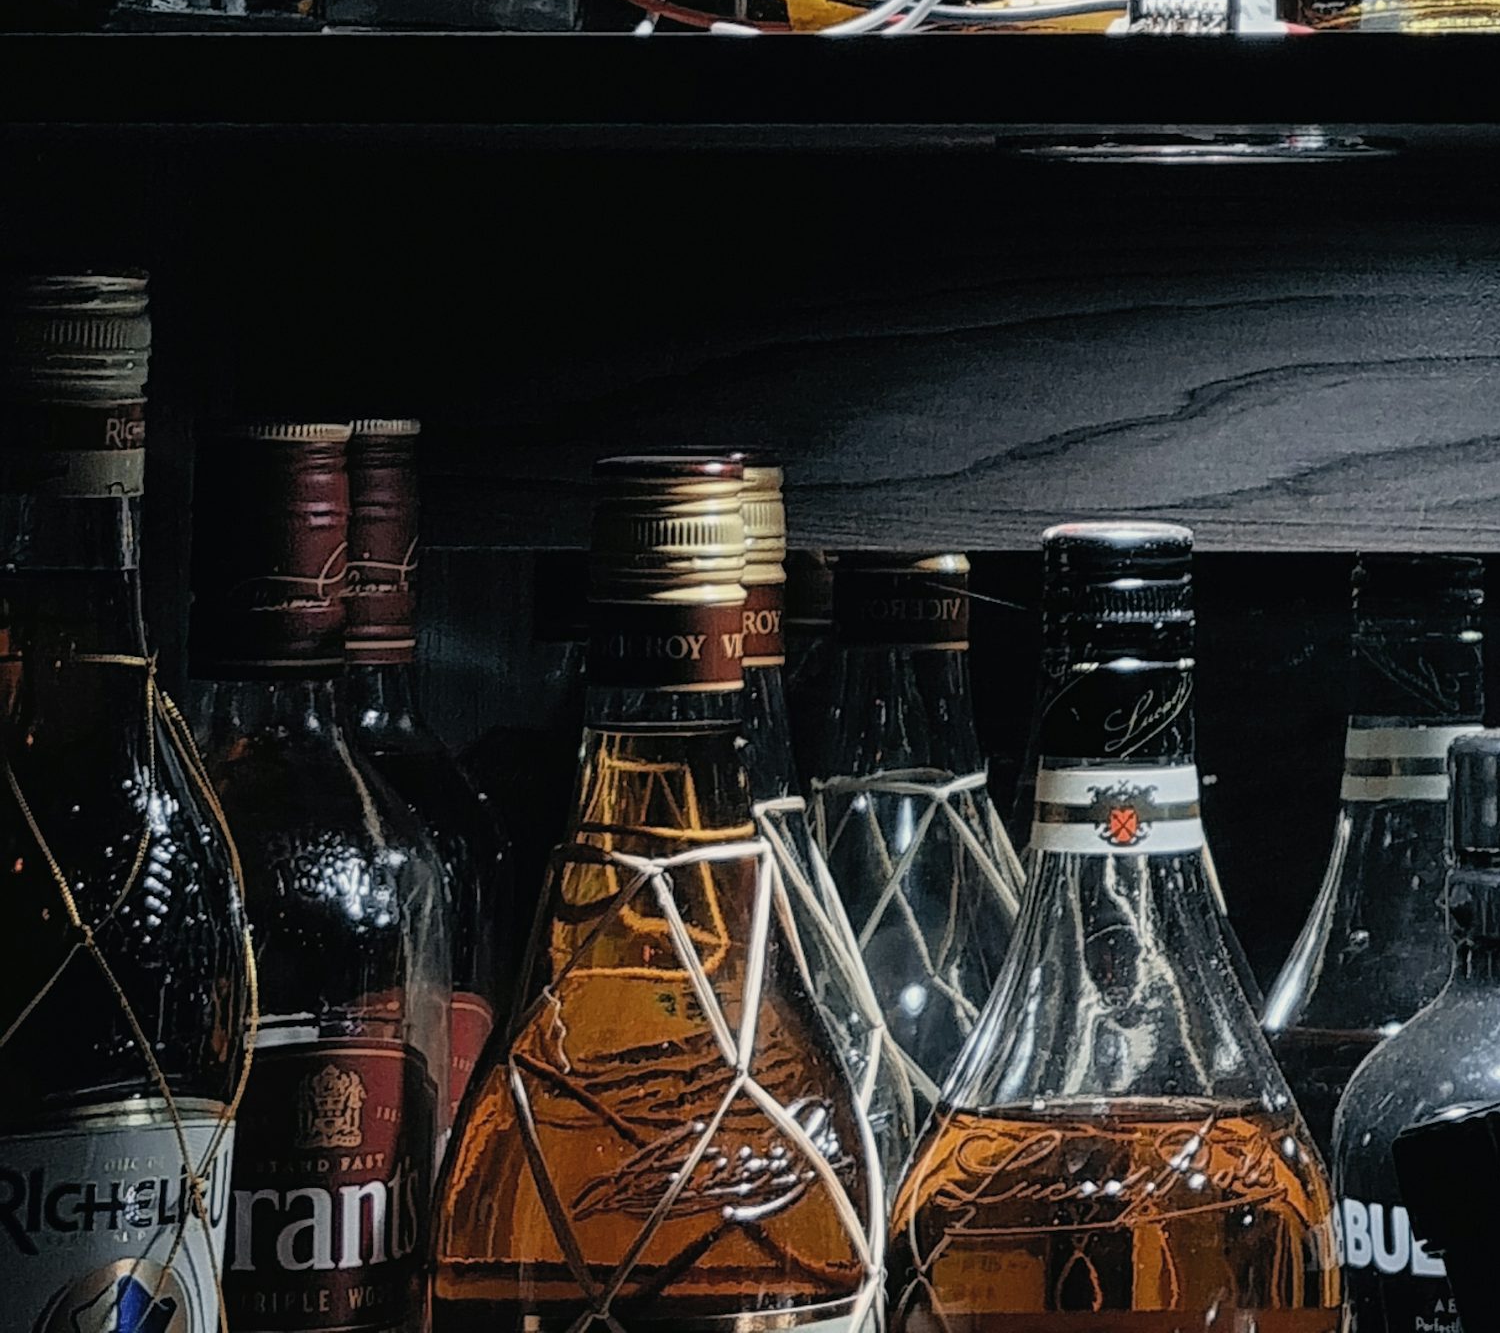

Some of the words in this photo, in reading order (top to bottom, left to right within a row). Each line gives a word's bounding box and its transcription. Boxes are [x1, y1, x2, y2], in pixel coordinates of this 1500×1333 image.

[741, 609, 783, 636] ROY
[340, 1152, 386, 1172] FAST
[231, 1155, 419, 1271] rant's
